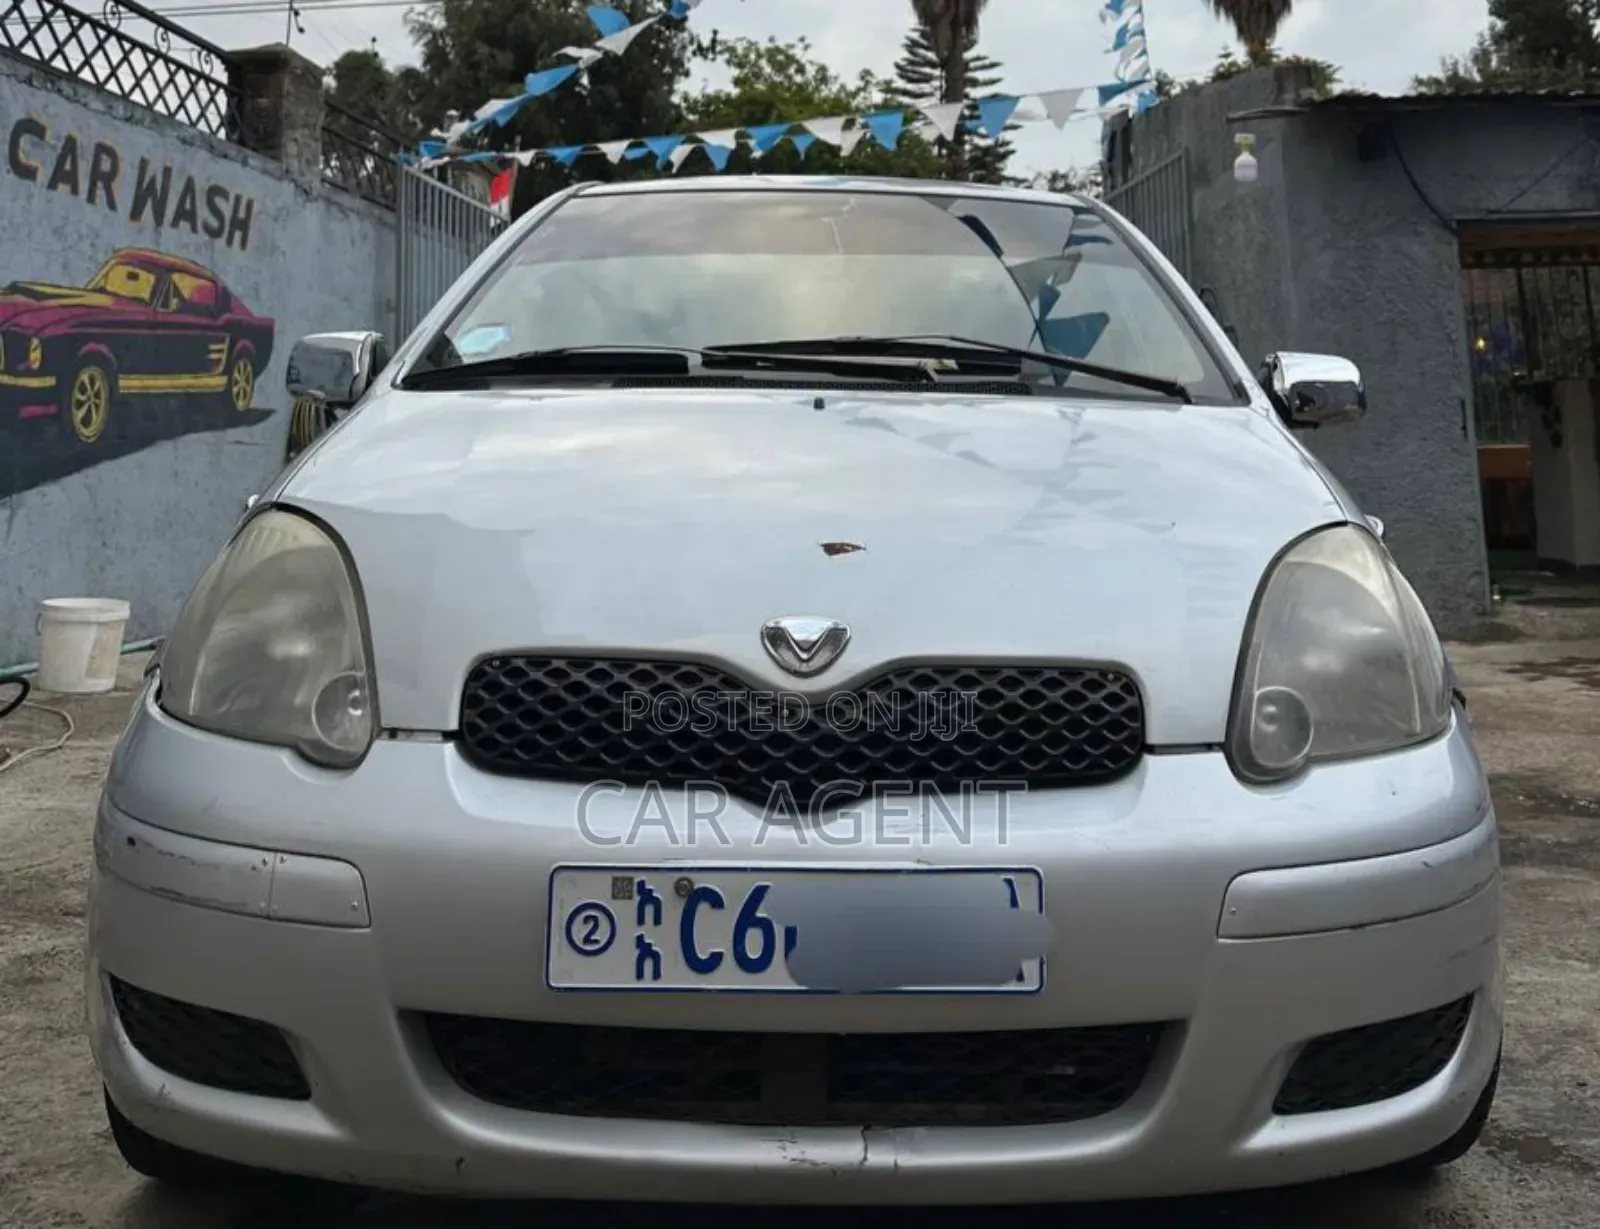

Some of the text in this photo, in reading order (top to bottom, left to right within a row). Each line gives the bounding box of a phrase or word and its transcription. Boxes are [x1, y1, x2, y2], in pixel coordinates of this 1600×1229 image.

[8, 117, 254, 250] CAR WASH
[681, 885, 797, 974] C6
